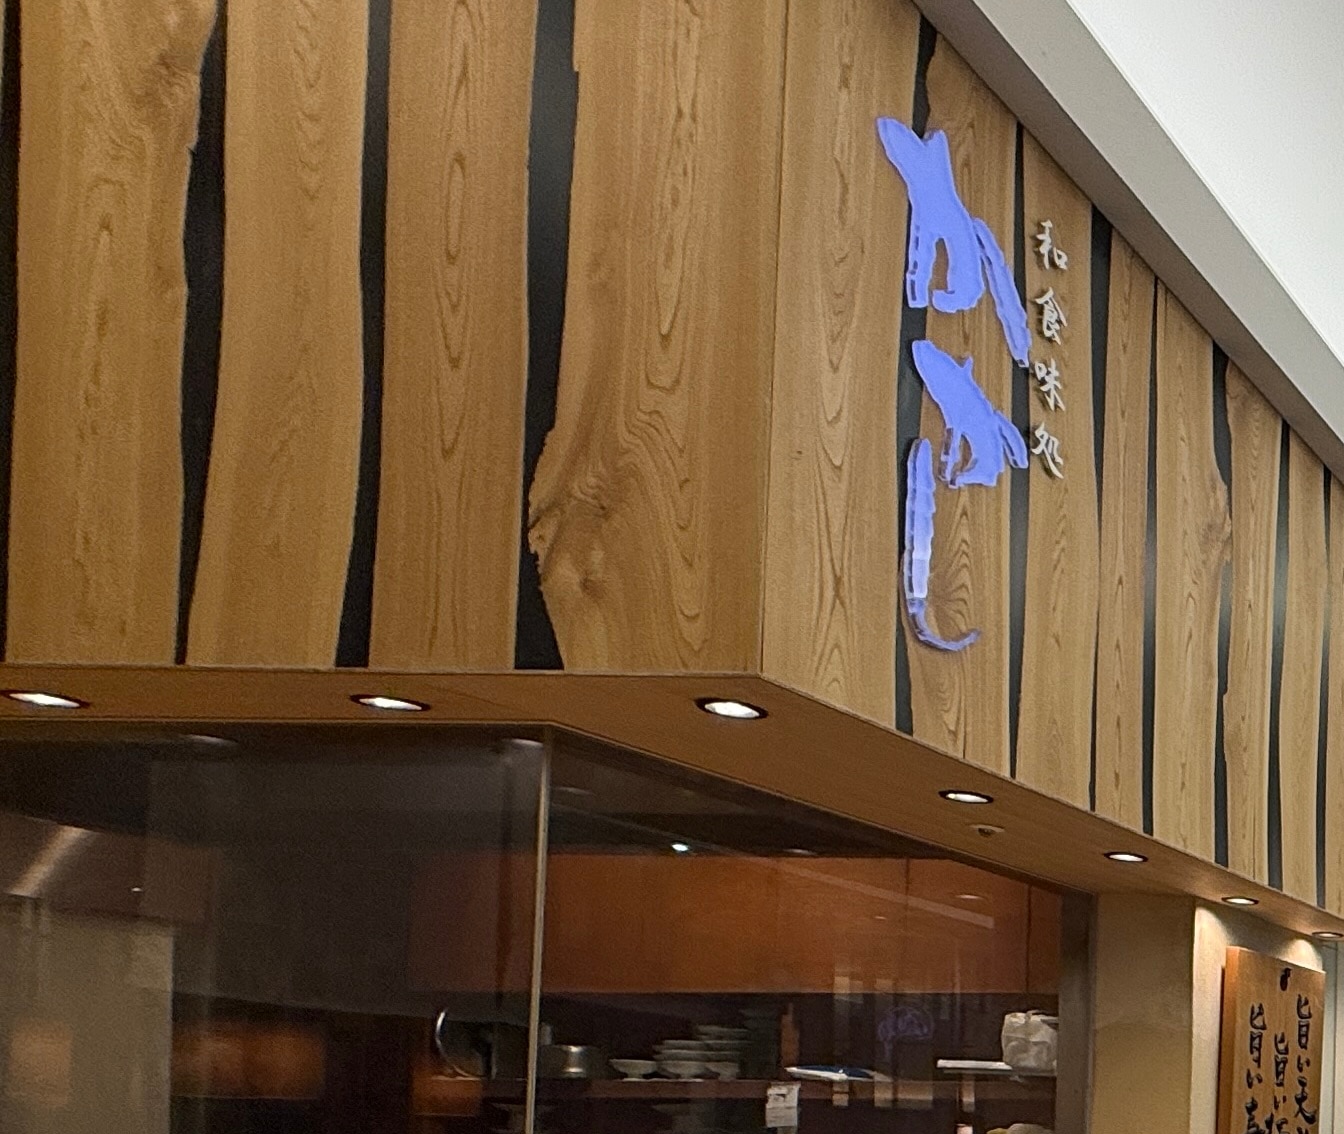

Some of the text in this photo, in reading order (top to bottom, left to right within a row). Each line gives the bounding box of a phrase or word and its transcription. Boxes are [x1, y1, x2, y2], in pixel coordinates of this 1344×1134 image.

[876, 115, 1032, 652] かかし
[1031, 219, 1069, 480] 和食味処
